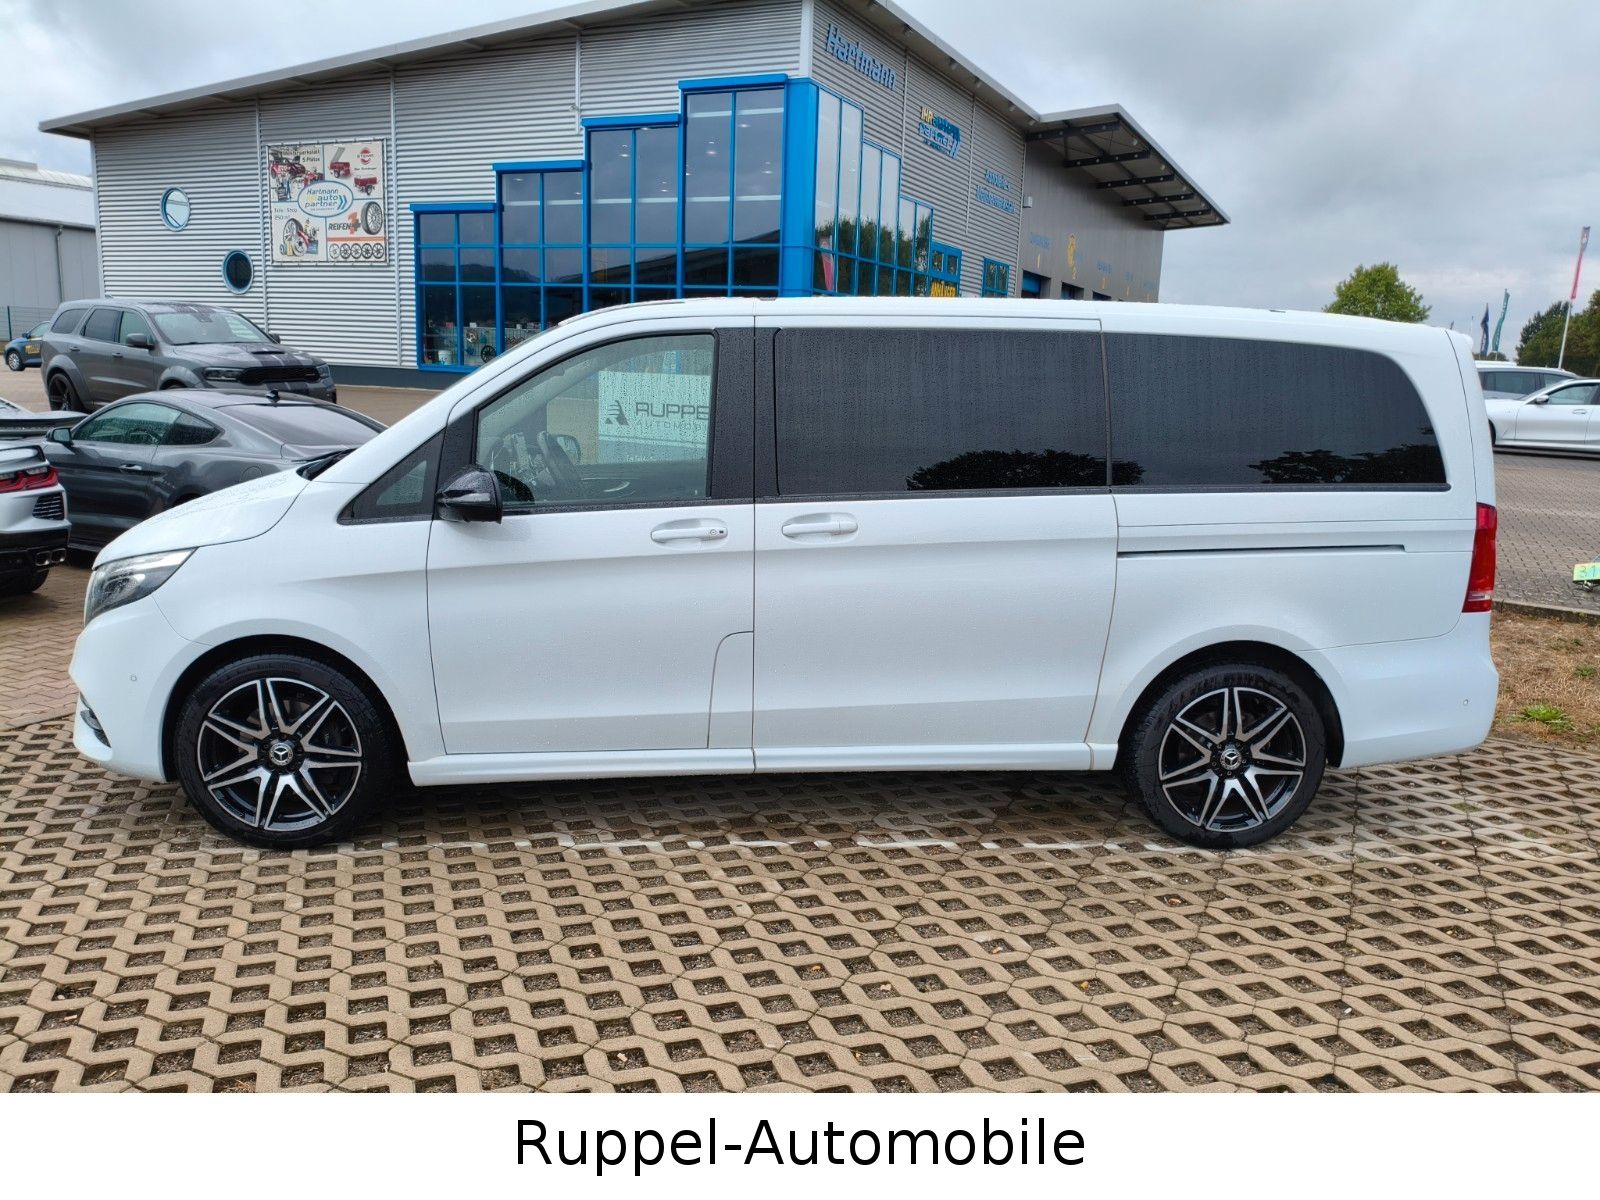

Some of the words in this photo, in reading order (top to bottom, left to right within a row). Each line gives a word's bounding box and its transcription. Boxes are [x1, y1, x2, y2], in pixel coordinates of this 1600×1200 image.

[826, 23, 898, 91] Hartmann
[317, 194, 339, 203] auto
[304, 201, 338, 209] partner
